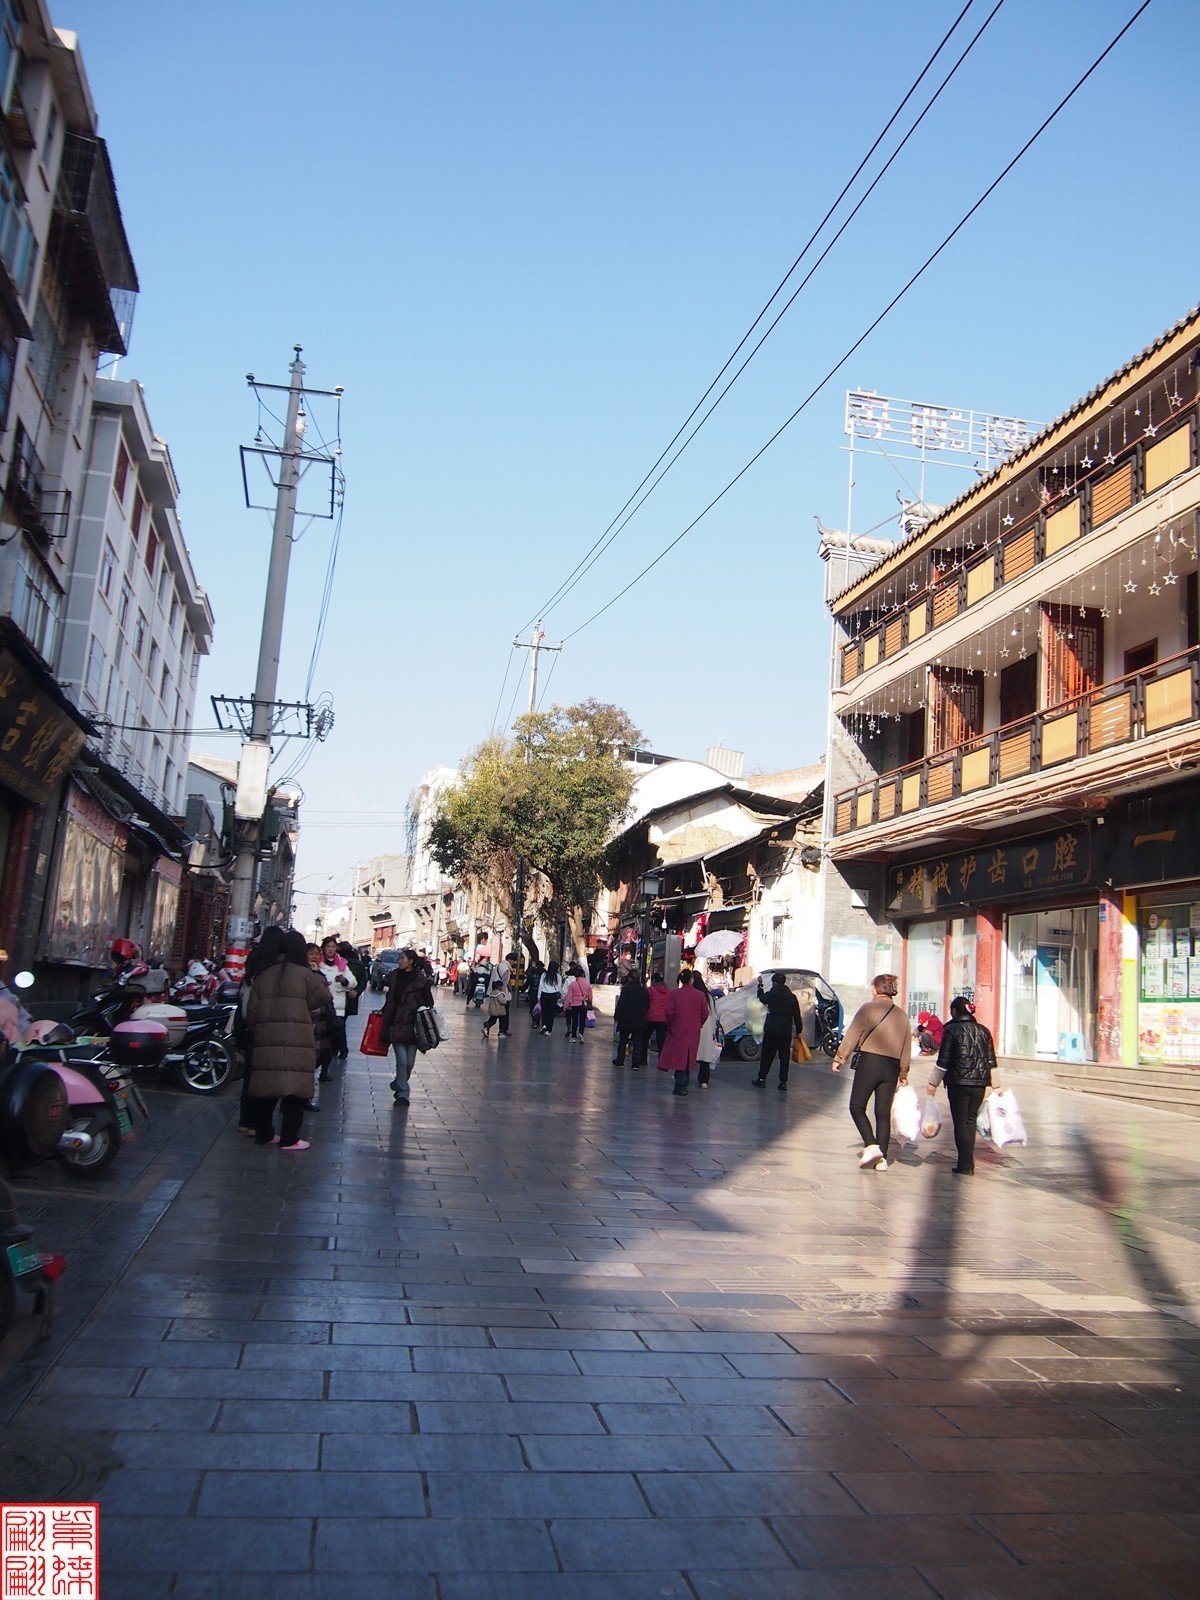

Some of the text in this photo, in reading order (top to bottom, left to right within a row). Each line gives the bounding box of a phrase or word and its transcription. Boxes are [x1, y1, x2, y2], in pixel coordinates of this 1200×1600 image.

[908, 833, 1079, 900] 精诚护齿口腔
